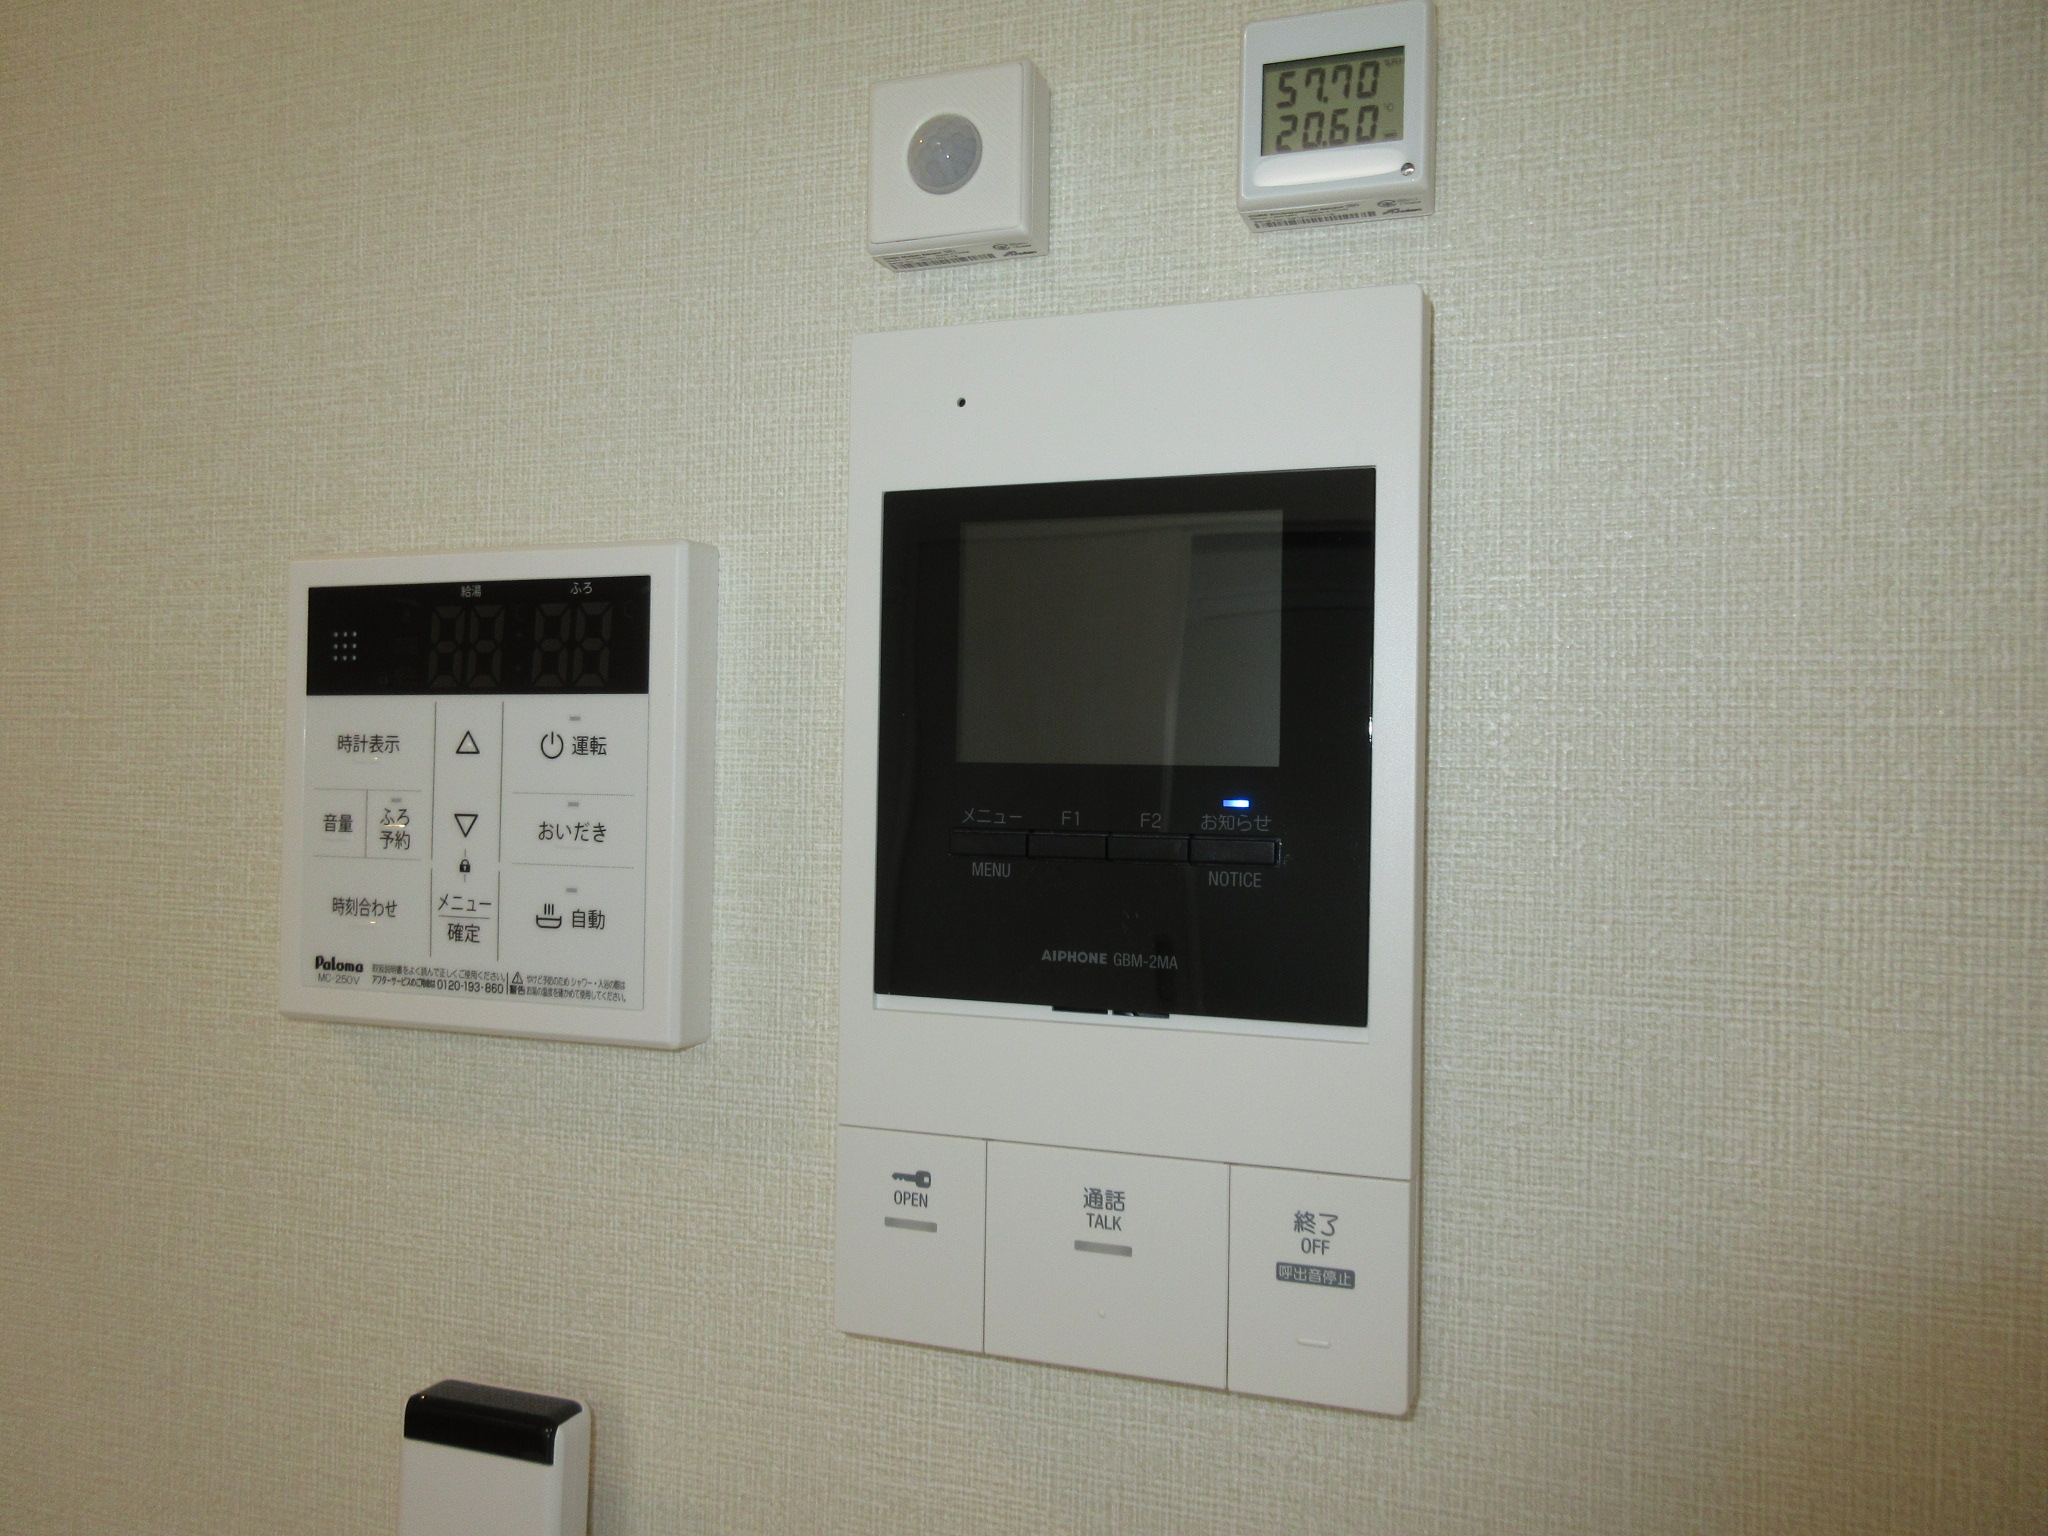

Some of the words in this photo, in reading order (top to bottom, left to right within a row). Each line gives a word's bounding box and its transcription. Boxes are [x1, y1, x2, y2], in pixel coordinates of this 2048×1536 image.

[1276, 60, 1380, 109] 57.70
[1275, 104, 1379, 151] 20.60
[461, 585, 482, 598] 給湯
[570, 582, 593, 594] ふろ
[337, 734, 400, 754] 時計表示
[572, 734, 607, 757] 運転
[323, 813, 353, 834] 音量
[379, 808, 411, 827] ふろ
[961, 807, 1023, 824] メニュー
[1061, 810, 1081, 826] F1
[1140, 813, 1162, 829] F2
[1200, 813, 1272, 832] お知らせ
[379, 831, 411, 851] 予約
[538, 821, 607, 842] おいだき
[972, 861, 1011, 878] MENU
[1208, 870, 1262, 888] NOTICE
[332, 897, 397, 918] 時刻合わせ
[437, 894, 491, 912] メニュー
[571, 909, 606, 930] 自動
[447, 923, 481, 943] 確定
[315, 955, 364, 973] Paloma
[1041, 949, 1108, 965] AIPHONE
[1113, 952, 1178, 970] GBM-2MA
[317, 972, 361, 985] MC-250V
[436, 981, 504, 994] 0120-193-860
[893, 1190, 928, 1208] OPEN
[1083, 1187, 1126, 1212] 通話
[1086, 1212, 1122, 1231] TALK
[1293, 1210, 1339, 1237] 終了
[1301, 1237, 1331, 1255] OFF
[1278, 1264, 1353, 1287] 呼出音停止
